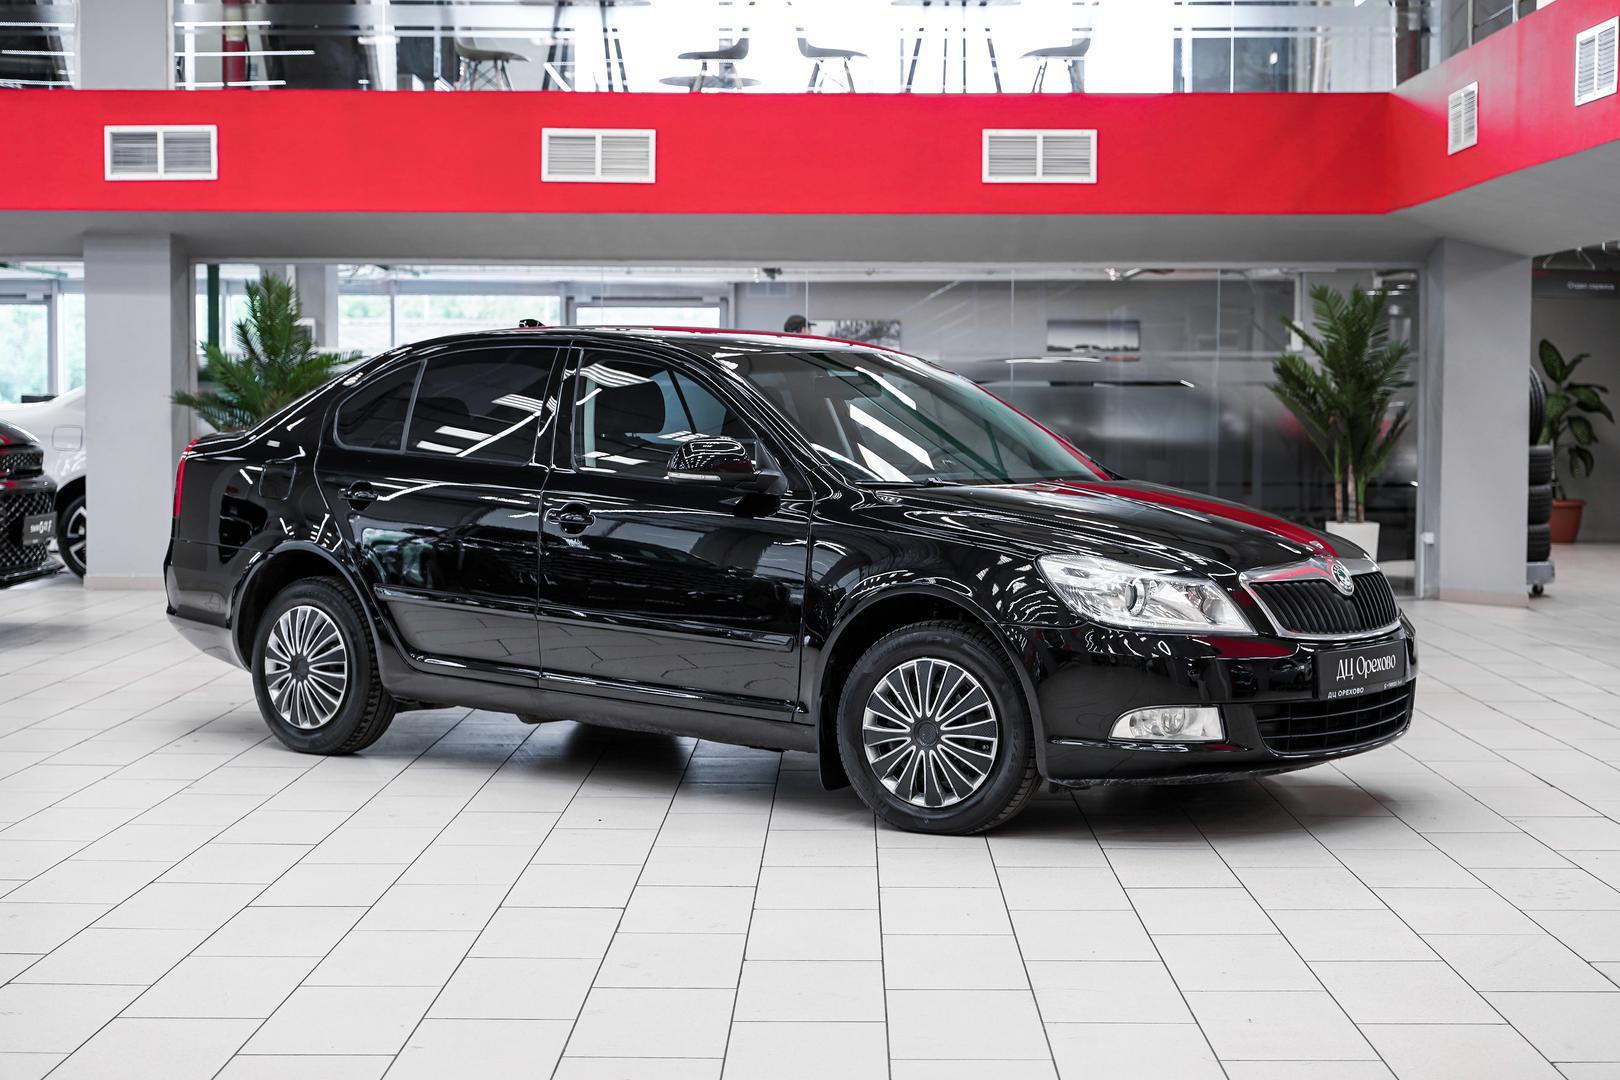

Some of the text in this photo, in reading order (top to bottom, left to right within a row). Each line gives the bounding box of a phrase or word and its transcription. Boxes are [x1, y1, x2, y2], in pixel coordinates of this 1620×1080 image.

[1336, 654, 1396, 682] ДЦ Орехово
[1328, 687, 1365, 699] ДЦ ОРЕХОВО
